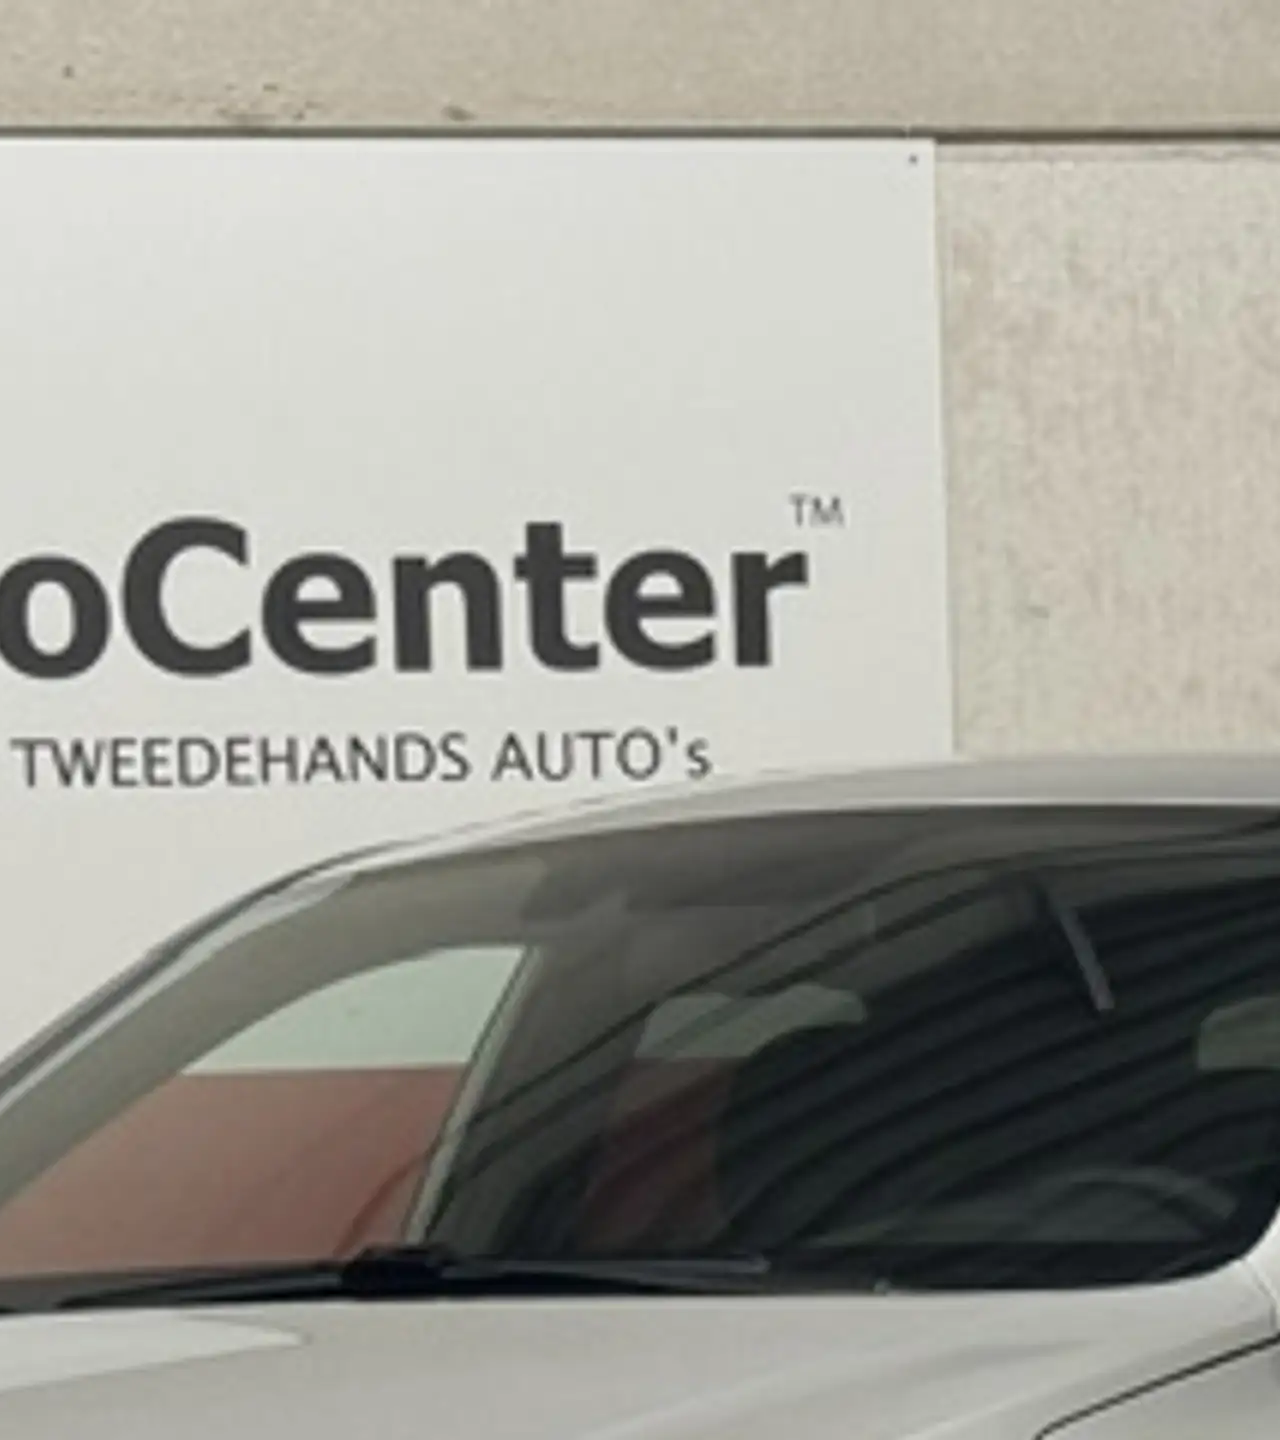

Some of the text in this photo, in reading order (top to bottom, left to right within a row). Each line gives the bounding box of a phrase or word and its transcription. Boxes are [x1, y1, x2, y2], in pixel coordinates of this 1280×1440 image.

[790, 493, 846, 528] TM
[10, 731, 472, 788] TWEEDEHANDS
[489, 726, 713, 782] AUTO's
